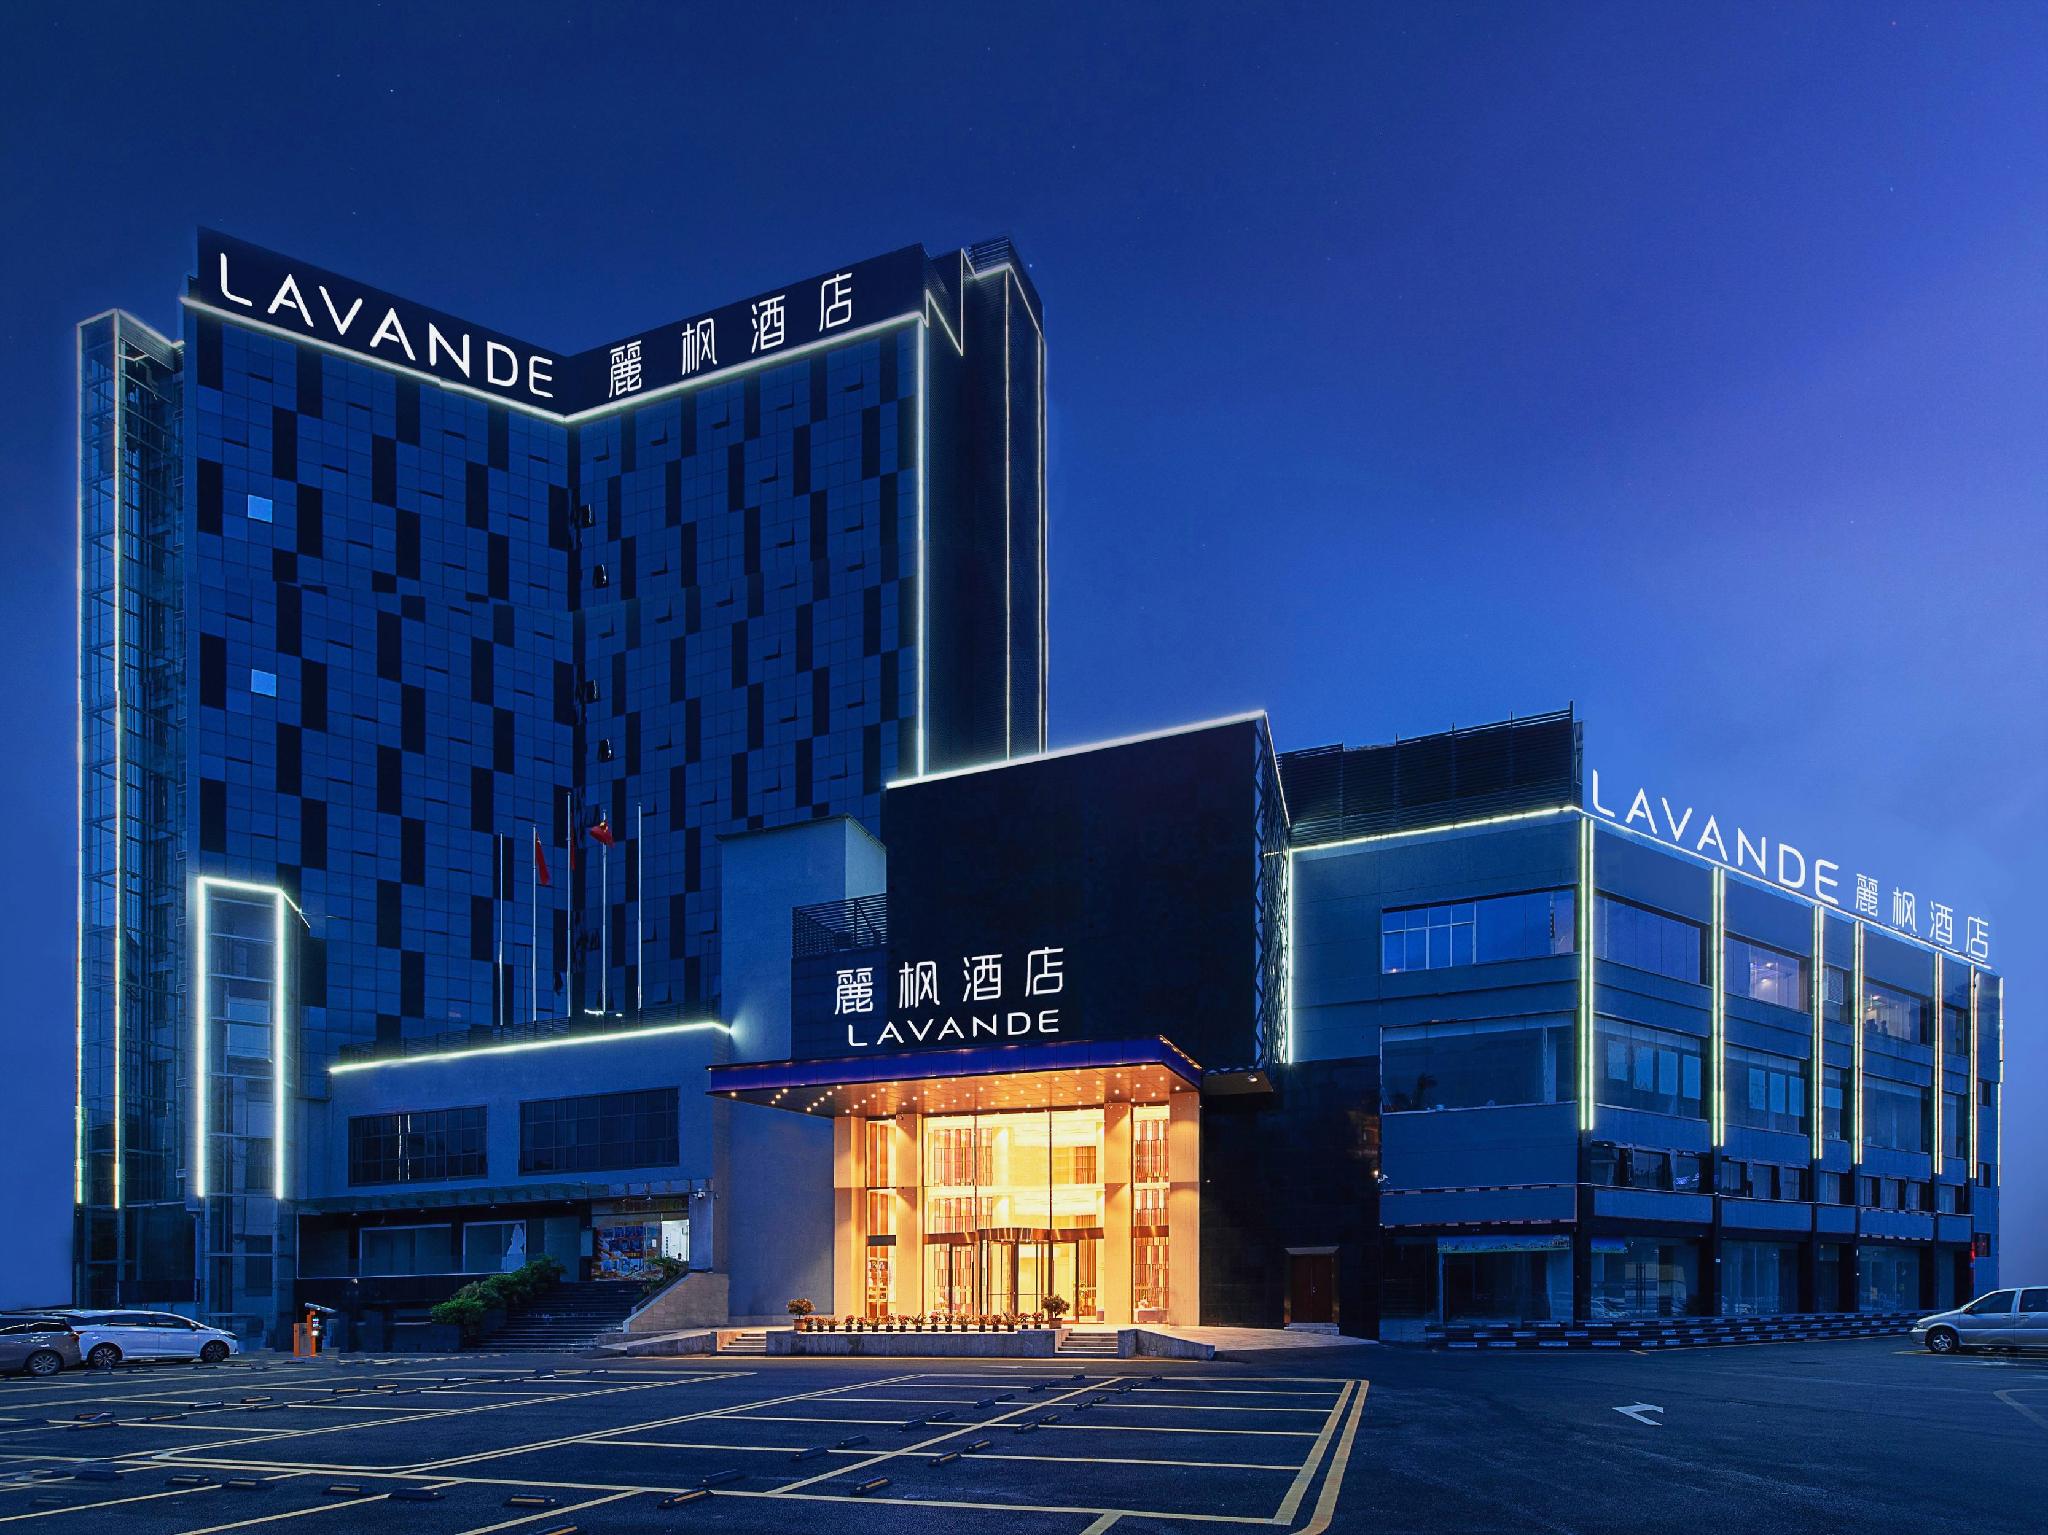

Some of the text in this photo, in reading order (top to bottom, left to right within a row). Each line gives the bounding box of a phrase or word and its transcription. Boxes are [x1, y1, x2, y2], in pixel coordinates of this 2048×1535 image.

[220, 252, 554, 398] LAVANDE
[1592, 769, 1840, 905] LAVANDE
[848, 1009, 1060, 1047] LAVANDE
